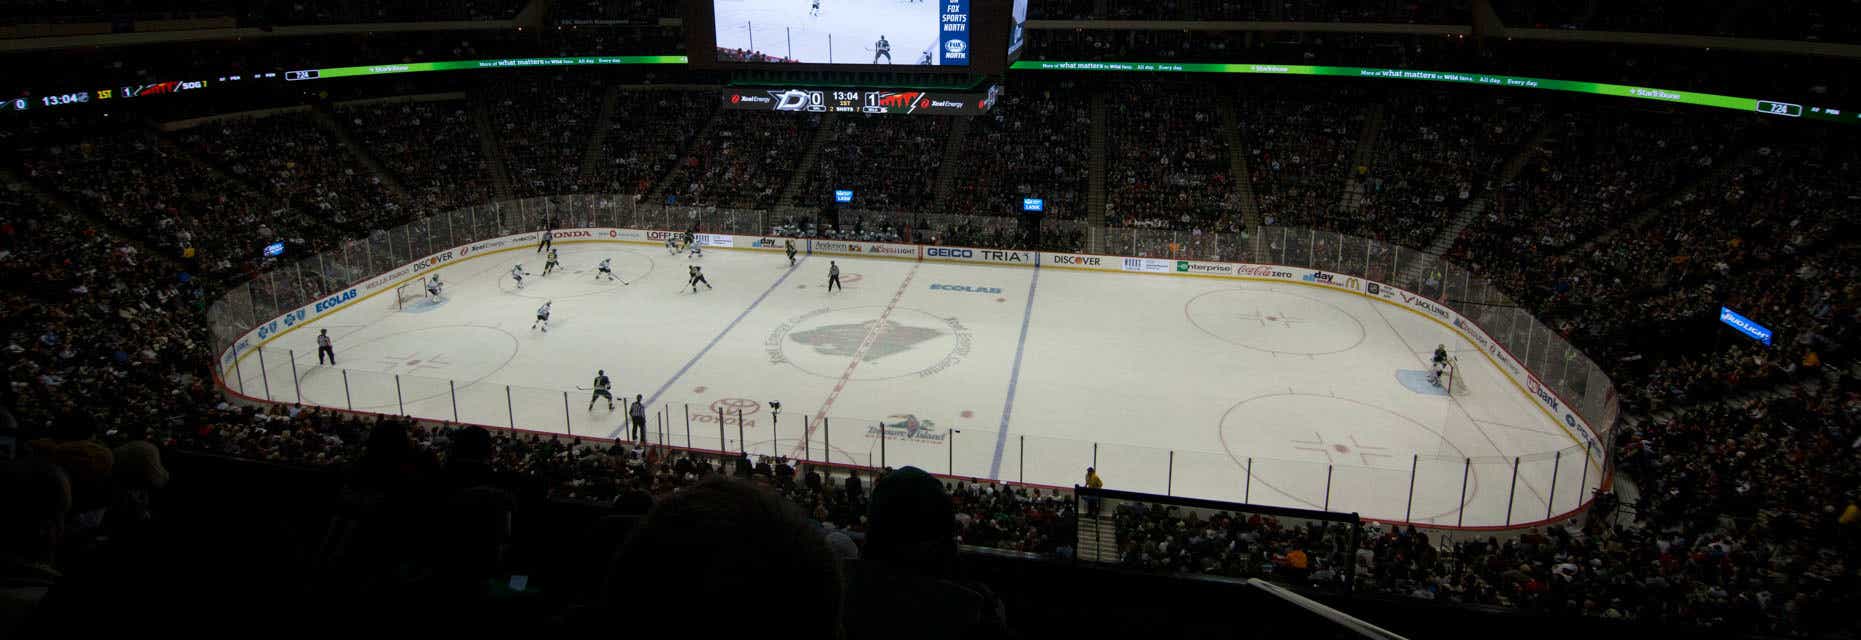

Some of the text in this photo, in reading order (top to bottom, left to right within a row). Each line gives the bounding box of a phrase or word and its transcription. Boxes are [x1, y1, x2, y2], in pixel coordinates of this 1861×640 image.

[947, 4, 960, 13] FOX
[942, 14, 967, 22] SPORTS
[943, 23, 966, 32] NORTH
[42, 93, 77, 107] 13:04
[97, 90, 112, 99] 1ST
[812, 93, 821, 105] 0
[833, 91, 858, 100] 13:04
[927, 248, 973, 258] GEICO
[982, 250, 1021, 262] TRIA
[413, 251, 454, 273] DISCOVER
[1054, 255, 1101, 266] DISCOVER
[1271, 270, 1293, 279] zero
[1314, 271, 1334, 282] day
[929, 283, 1002, 295] ECOLAB
[316, 289, 358, 313] ECOLAB
[1537, 387, 1559, 413] bank
[915, 431, 946, 441] Island
